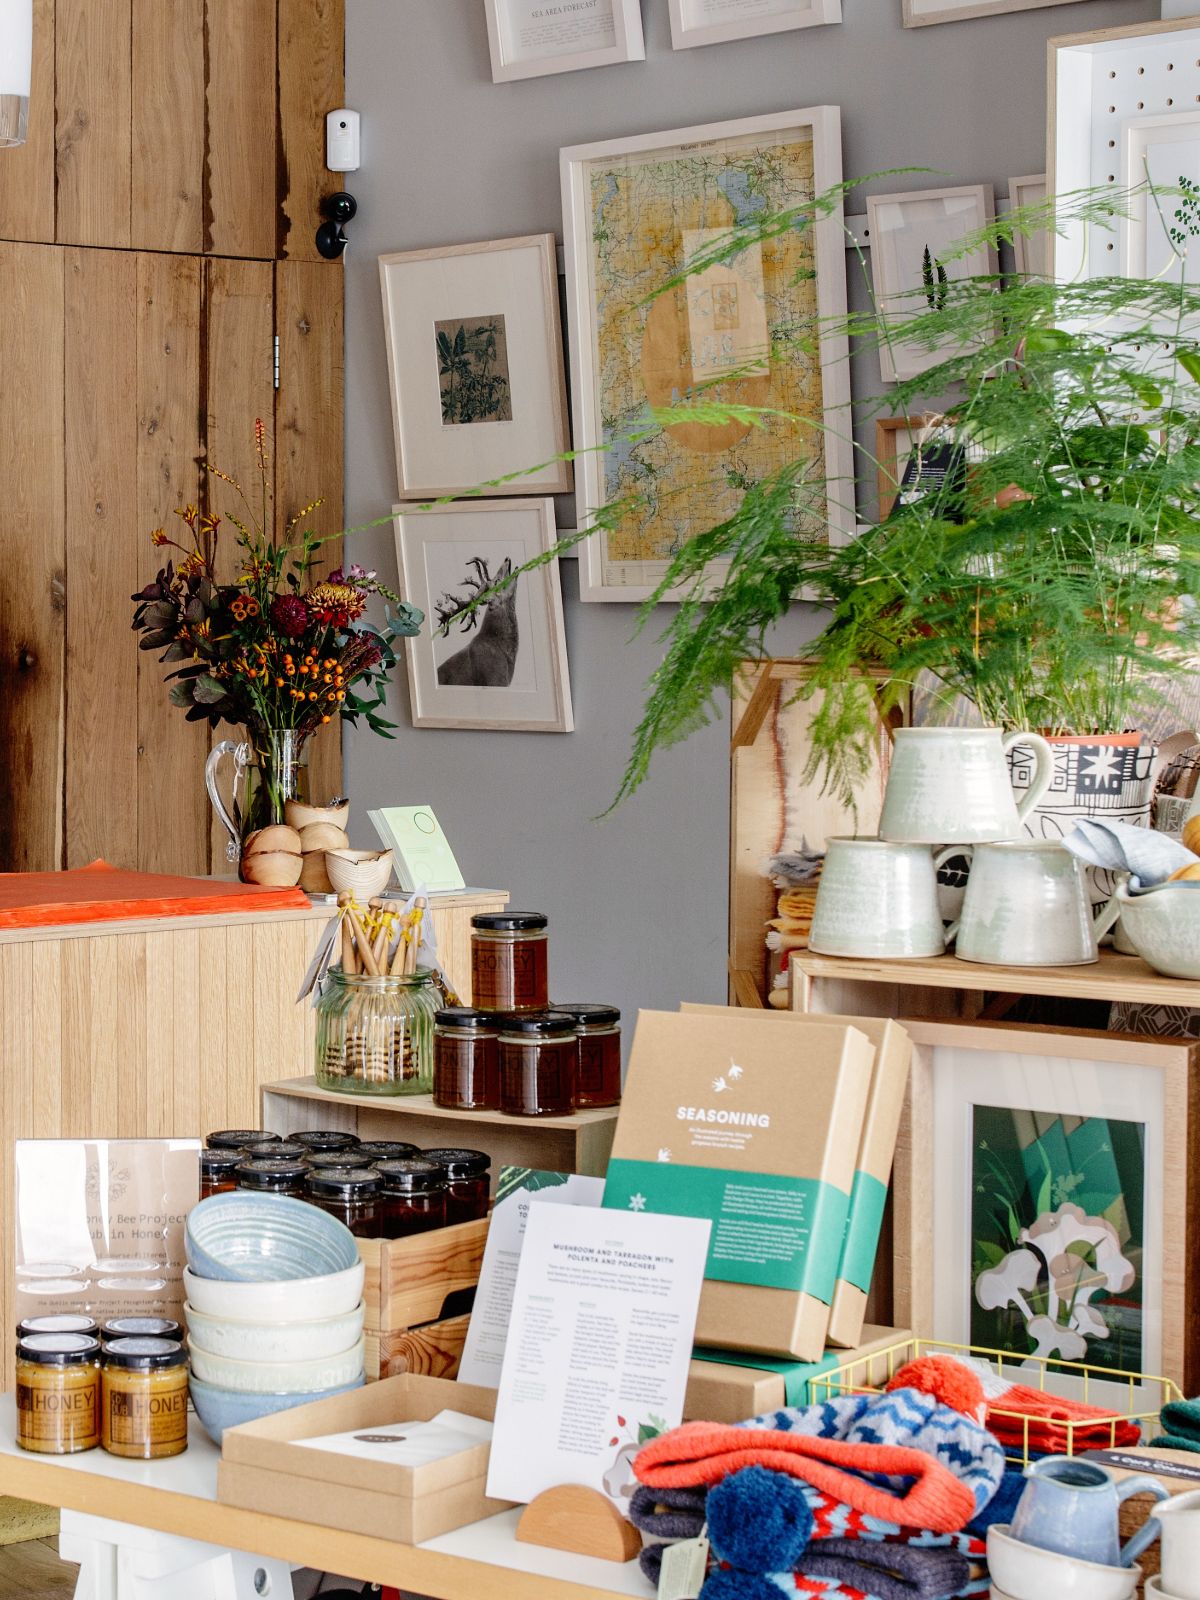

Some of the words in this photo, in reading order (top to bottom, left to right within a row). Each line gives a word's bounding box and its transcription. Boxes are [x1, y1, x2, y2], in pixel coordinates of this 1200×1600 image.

[532, 10, 544, 18] SEA
[545, 7, 562, 16] AREA
[563, 1, 597, 14] FORECAST
[676, 1106, 770, 1128] SEASONING
[117, 1214, 137, 1224] Bee
[140, 1213, 188, 1227] Project
[553, 1243, 595, 1255] MUSHROOM
[597, 1249, 612, 1257] AND
[614, 1251, 652, 1262] TARRAGON
[655, 1256, 674, 1264] WITH
[567, 1253, 599, 1263] POLENTA
[601, 1258, 616, 1266] AND
[618, 1260, 656, 1271] POACHERS
[35, 1391, 94, 1411] HONEY
[136, 1393, 188, 1415] HONEY
